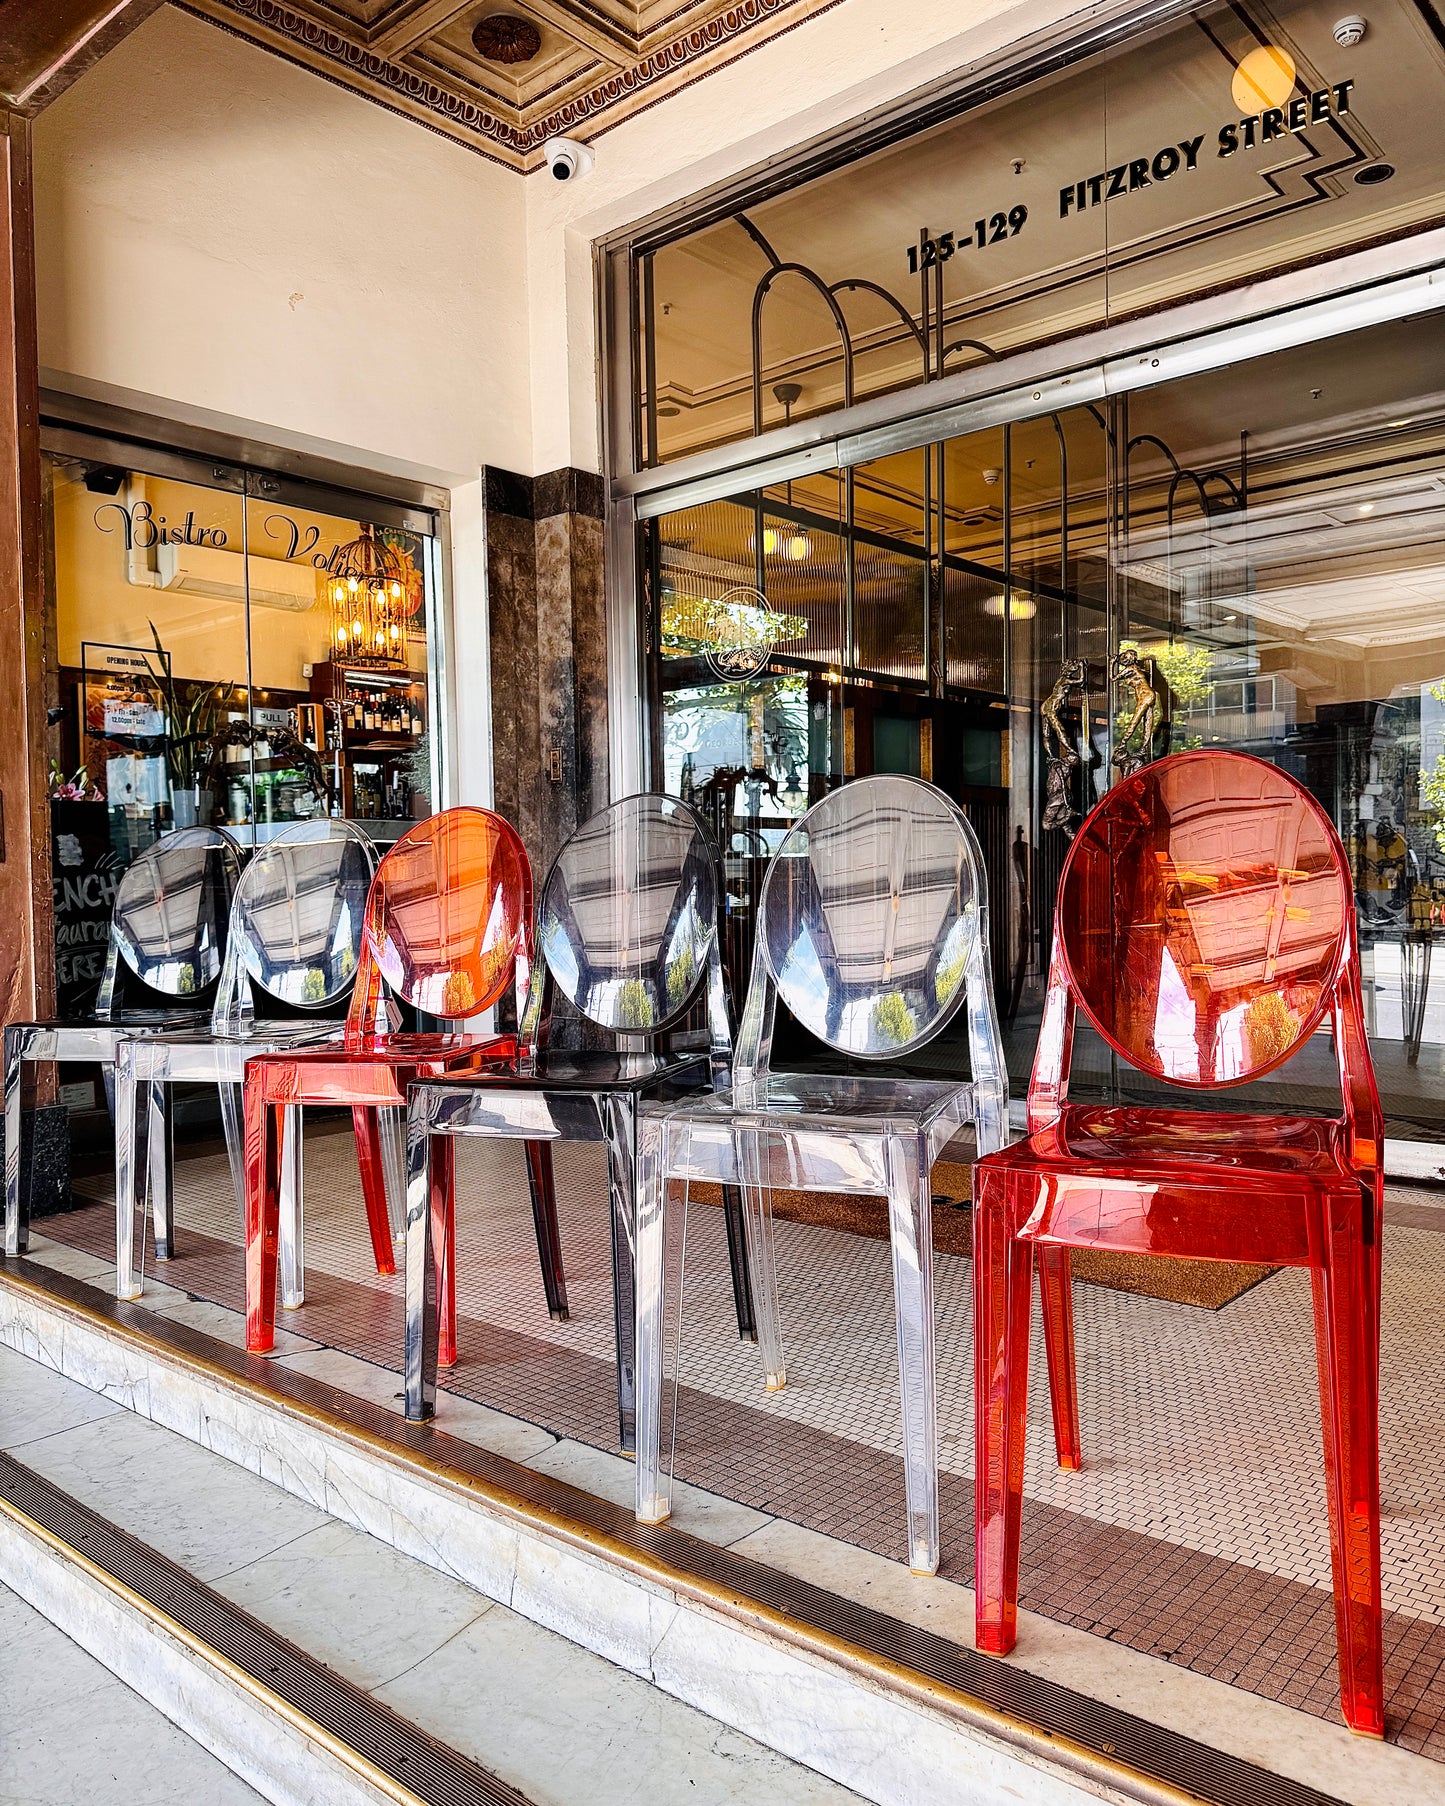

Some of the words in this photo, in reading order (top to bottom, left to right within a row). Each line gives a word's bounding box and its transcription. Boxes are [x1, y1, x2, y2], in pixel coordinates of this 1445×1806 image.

[906, 204, 1029, 274] 125-129
[1059, 134, 1206, 218] FITZROY
[1217, 79, 1355, 158] STREET
[94, 501, 228, 550] Bistro
[106, 656, 129, 666] OPENING
[261, 713, 283, 723] PULL
